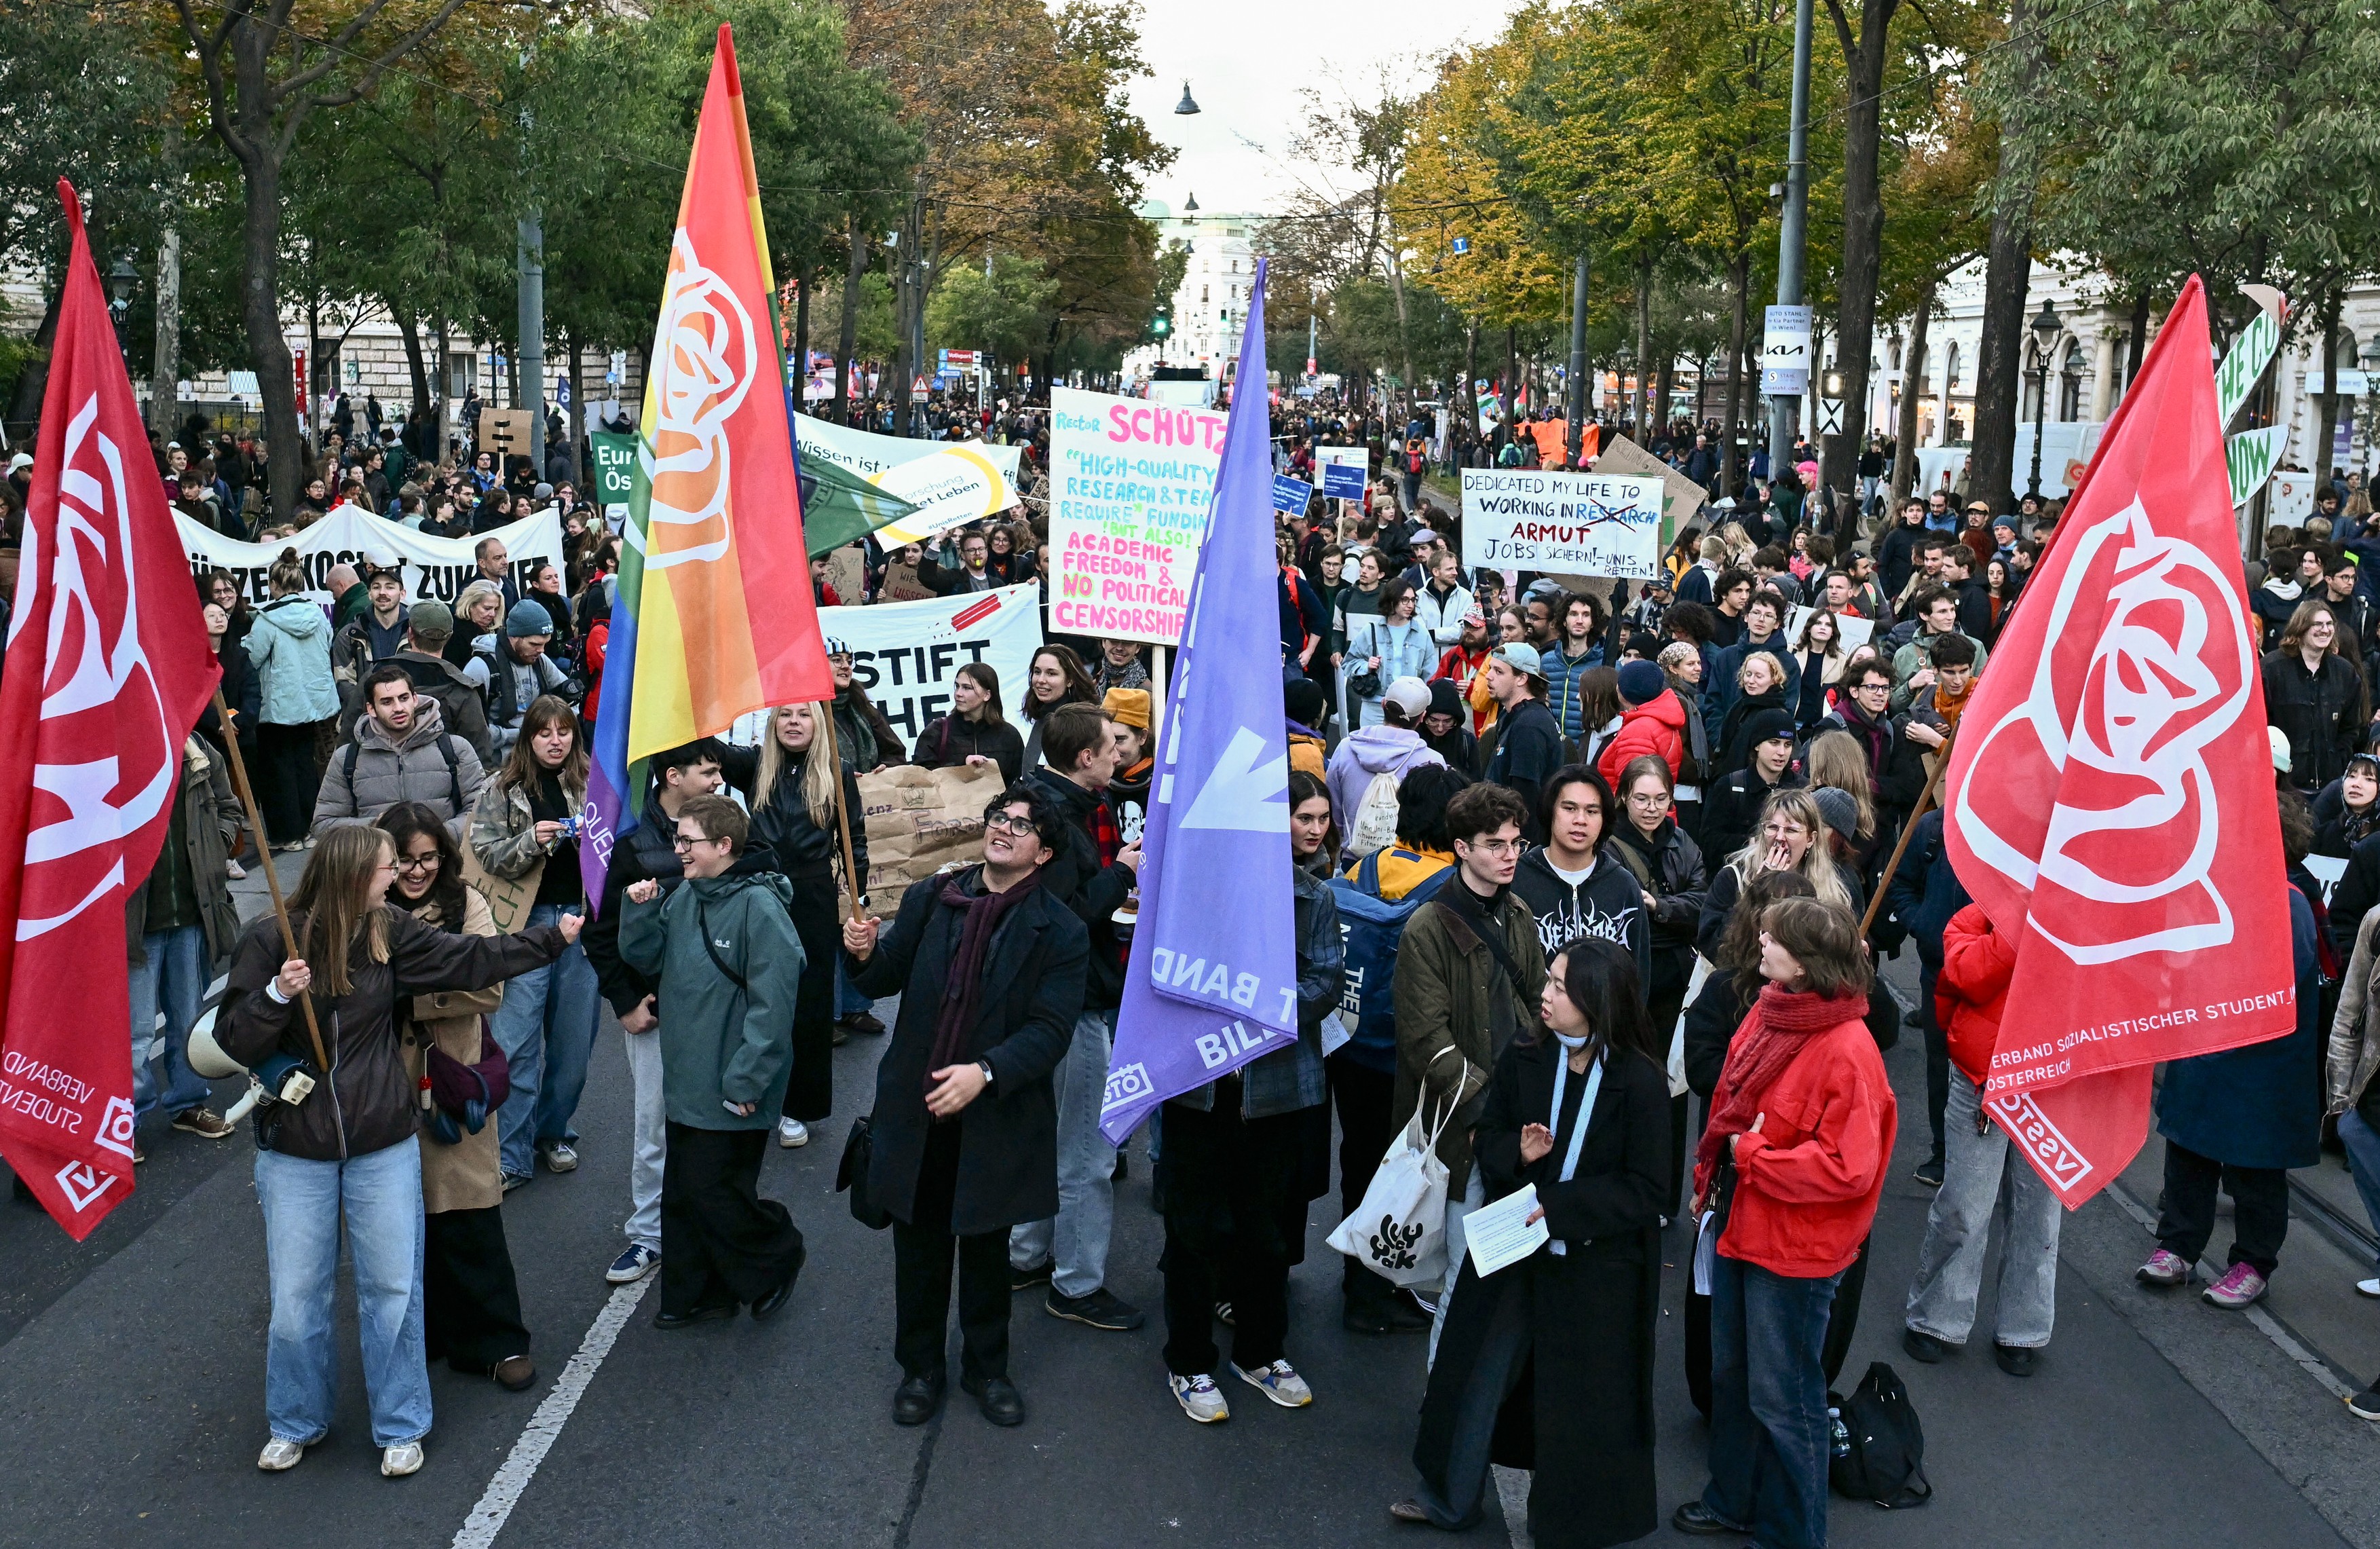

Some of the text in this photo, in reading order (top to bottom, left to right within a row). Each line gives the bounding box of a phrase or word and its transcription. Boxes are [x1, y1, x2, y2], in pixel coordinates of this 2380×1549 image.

[598, 445, 635, 465] Eur
[859, 457, 880, 473] ist
[605, 466, 632, 491] Ös
[1068, 477, 1156, 503] RESEARCH
[1465, 475, 1640, 499] DEDICATED MY LIFE TO
[937, 482, 980, 501] Leben
[1479, 497, 1555, 518] WORKING
[1561, 504, 1574, 519] IN
[1145, 527, 1192, 549] ALSO!
[1511, 522, 1591, 544] ARMUT
[1068, 531, 1173, 563] ACADEMIC
[1485, 538, 1536, 560] JOBS
[900, 572, 916, 584] WIE
[1063, 551, 1174, 586] FREEDOM &
[1604, 563, 1655, 577] RETTEN!
[1063, 573, 1188, 608] NO POLITICAL
[1055, 601, 1186, 637] CENSORSHIP
[854, 639, 990, 690] STIFT
[584, 802, 615, 871] QUEE
[1344, 967, 1364, 1013] THE
[1194, 1020, 1279, 1070] BIL
[1990, 1042, 2053, 1069] ERBAND
[2056, 1008, 2199, 1053] SOZIALISTISCHER
